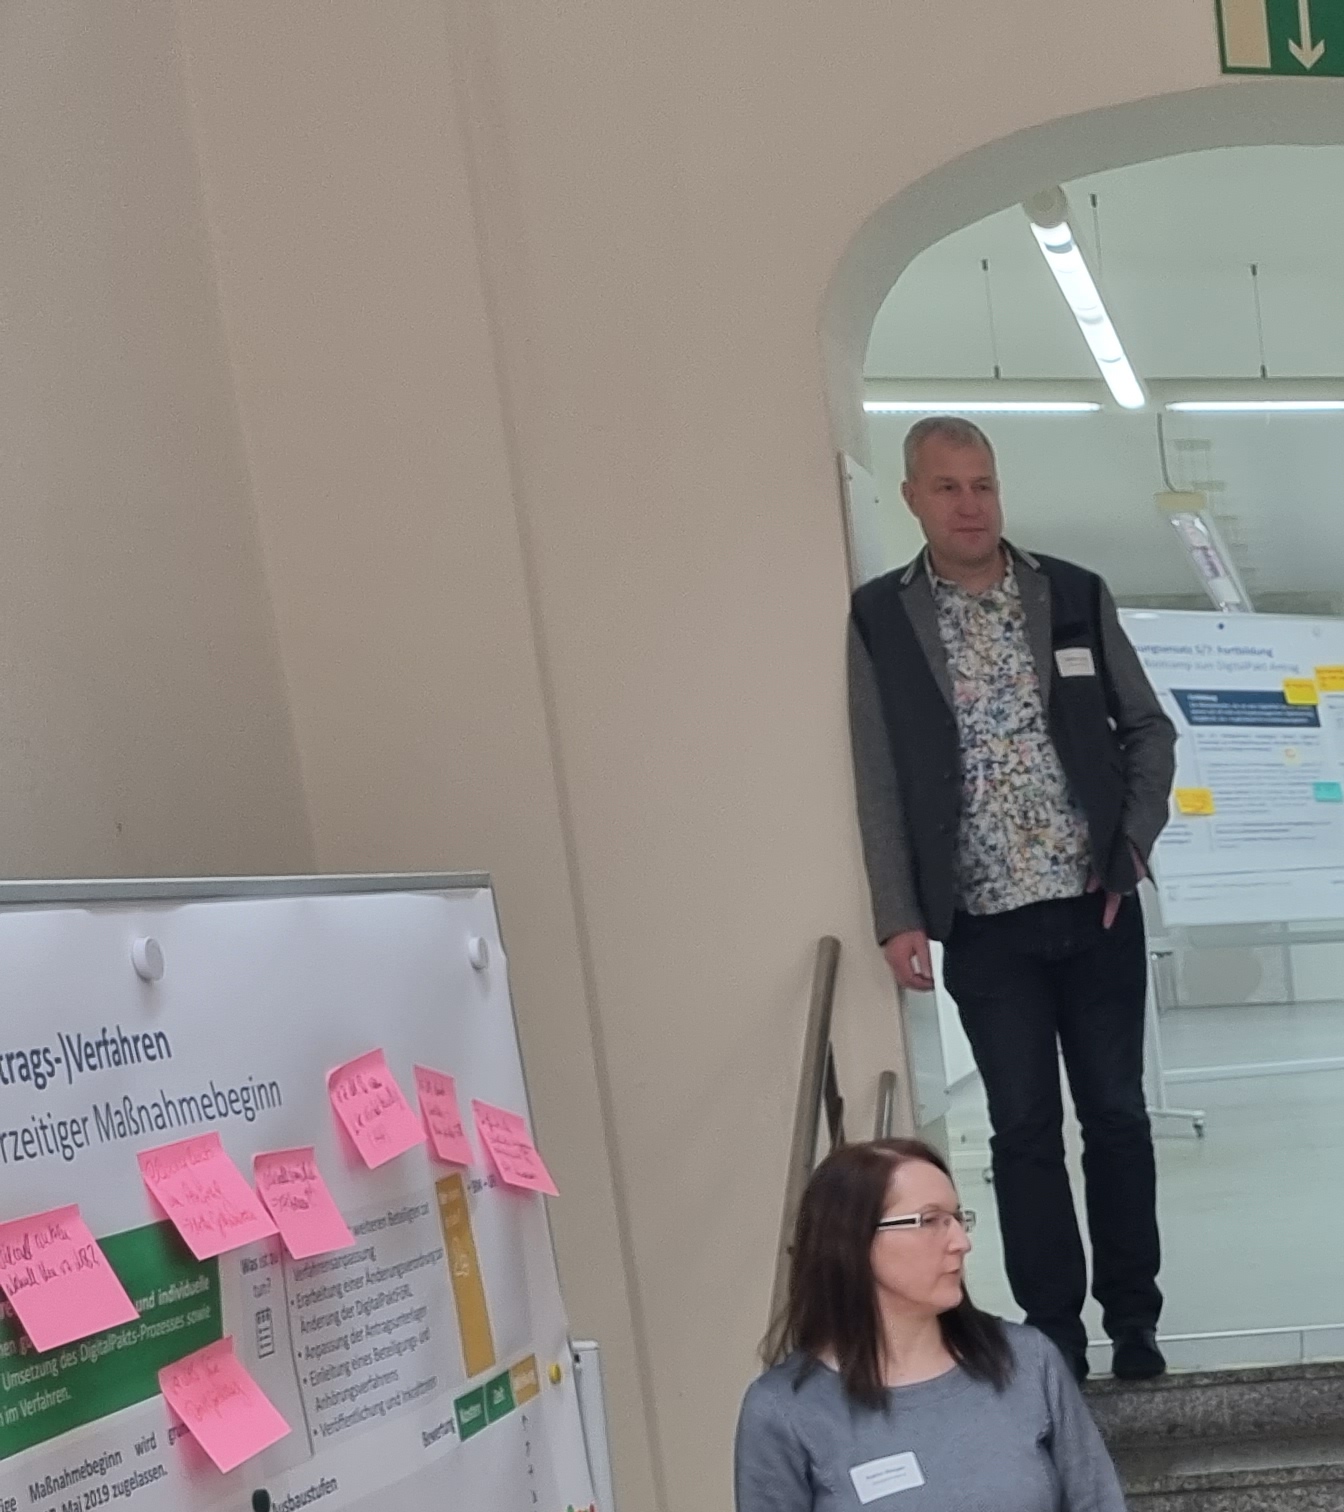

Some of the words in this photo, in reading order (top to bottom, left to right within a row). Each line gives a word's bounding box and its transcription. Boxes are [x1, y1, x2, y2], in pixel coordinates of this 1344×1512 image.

[93, 1076, 283, 1143] Maßnahmebeginn
[2, 1356, 58, 1391] Umsetzung
[60, 1349, 78, 1369] des
[5, 1404, 20, 1424] im
[28, 1450, 124, 1503] Maßnahmebeginn
[134, 1431, 157, 1457] wird
[83, 1483, 111, 1512] 2019
[111, 1462, 168, 1500] zugelassen.
